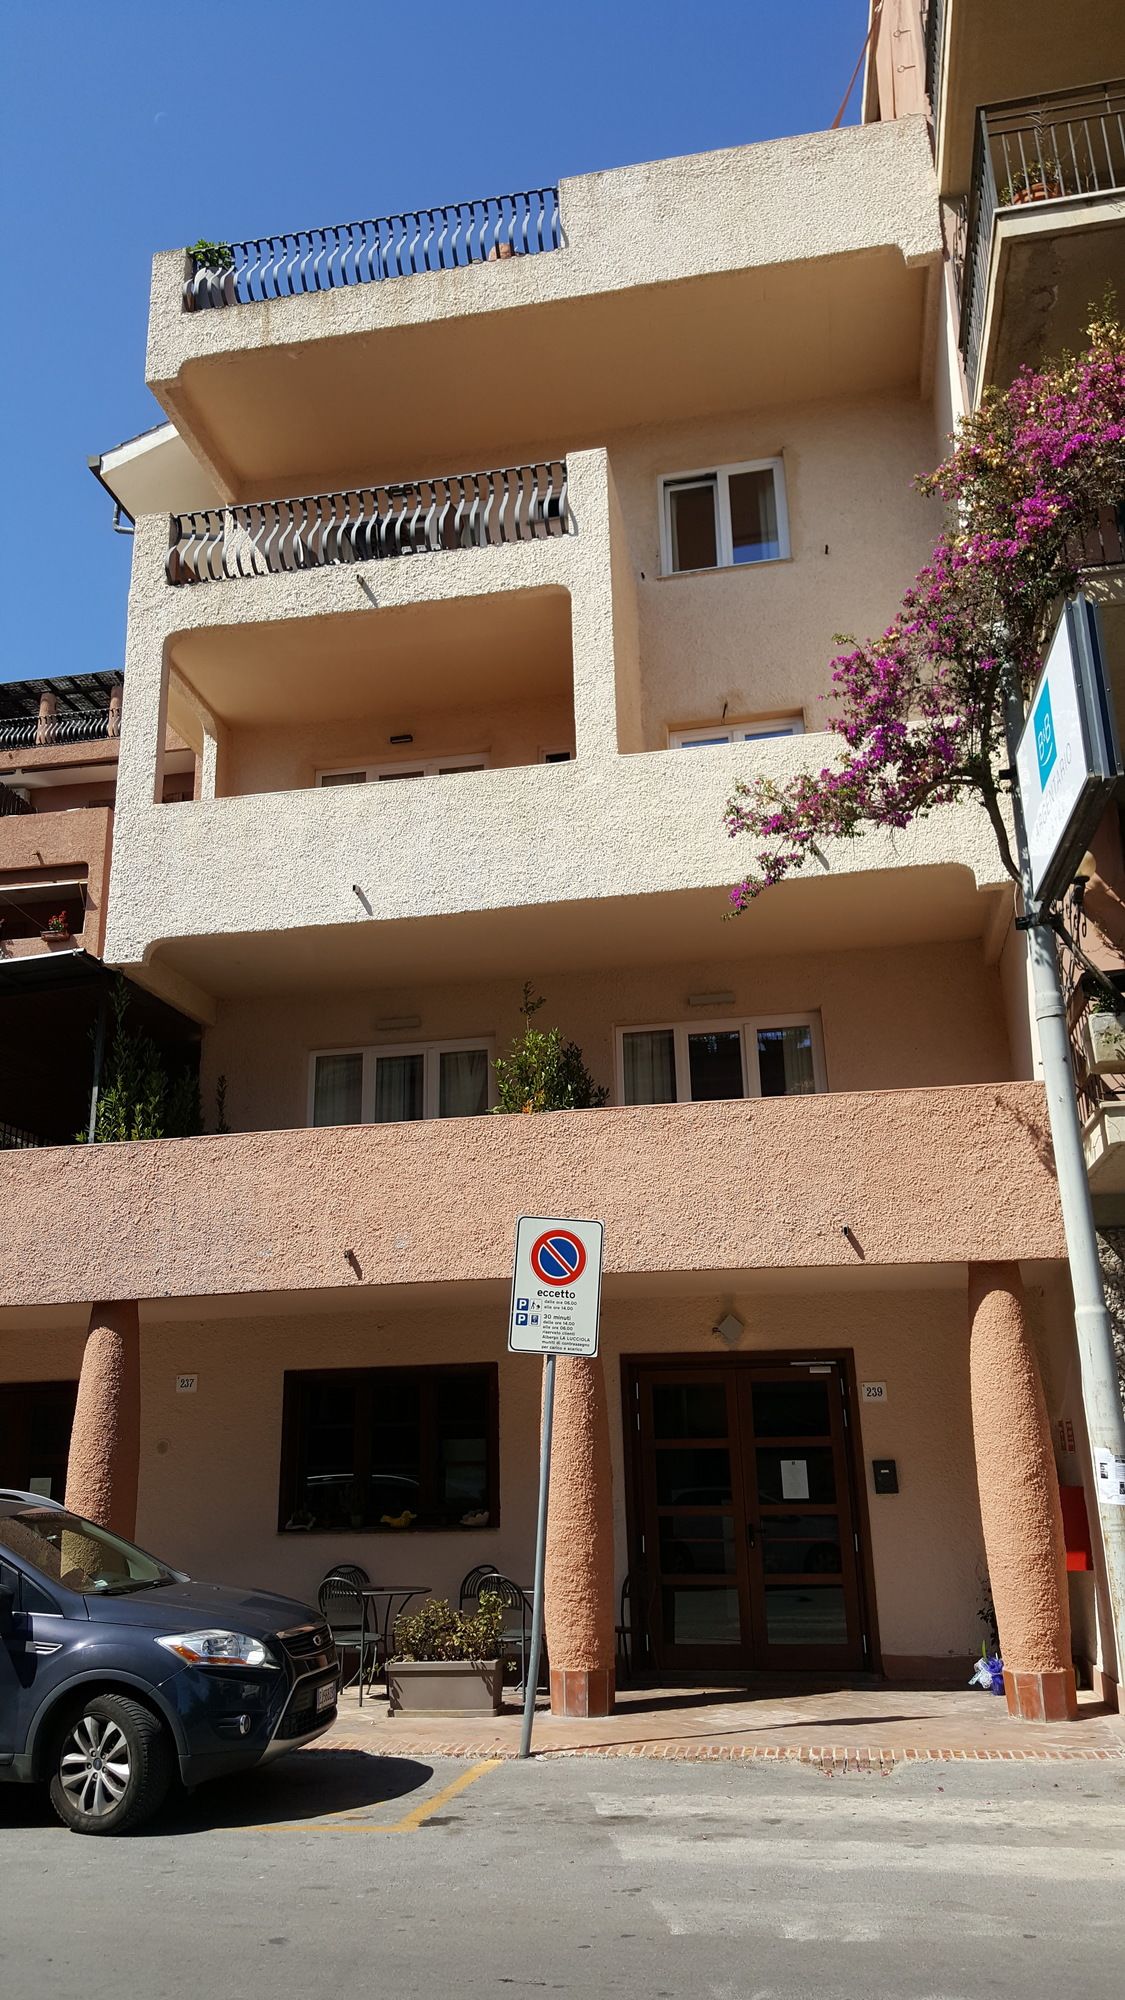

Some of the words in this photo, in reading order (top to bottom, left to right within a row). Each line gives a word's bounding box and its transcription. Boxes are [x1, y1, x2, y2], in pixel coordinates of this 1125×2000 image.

[1035, 742, 1072, 837] ARGENTARIO
[537, 1290, 575, 1299] eccetto
[180, 1379, 194, 1388] 237
[866, 1386, 882, 1396] 239
